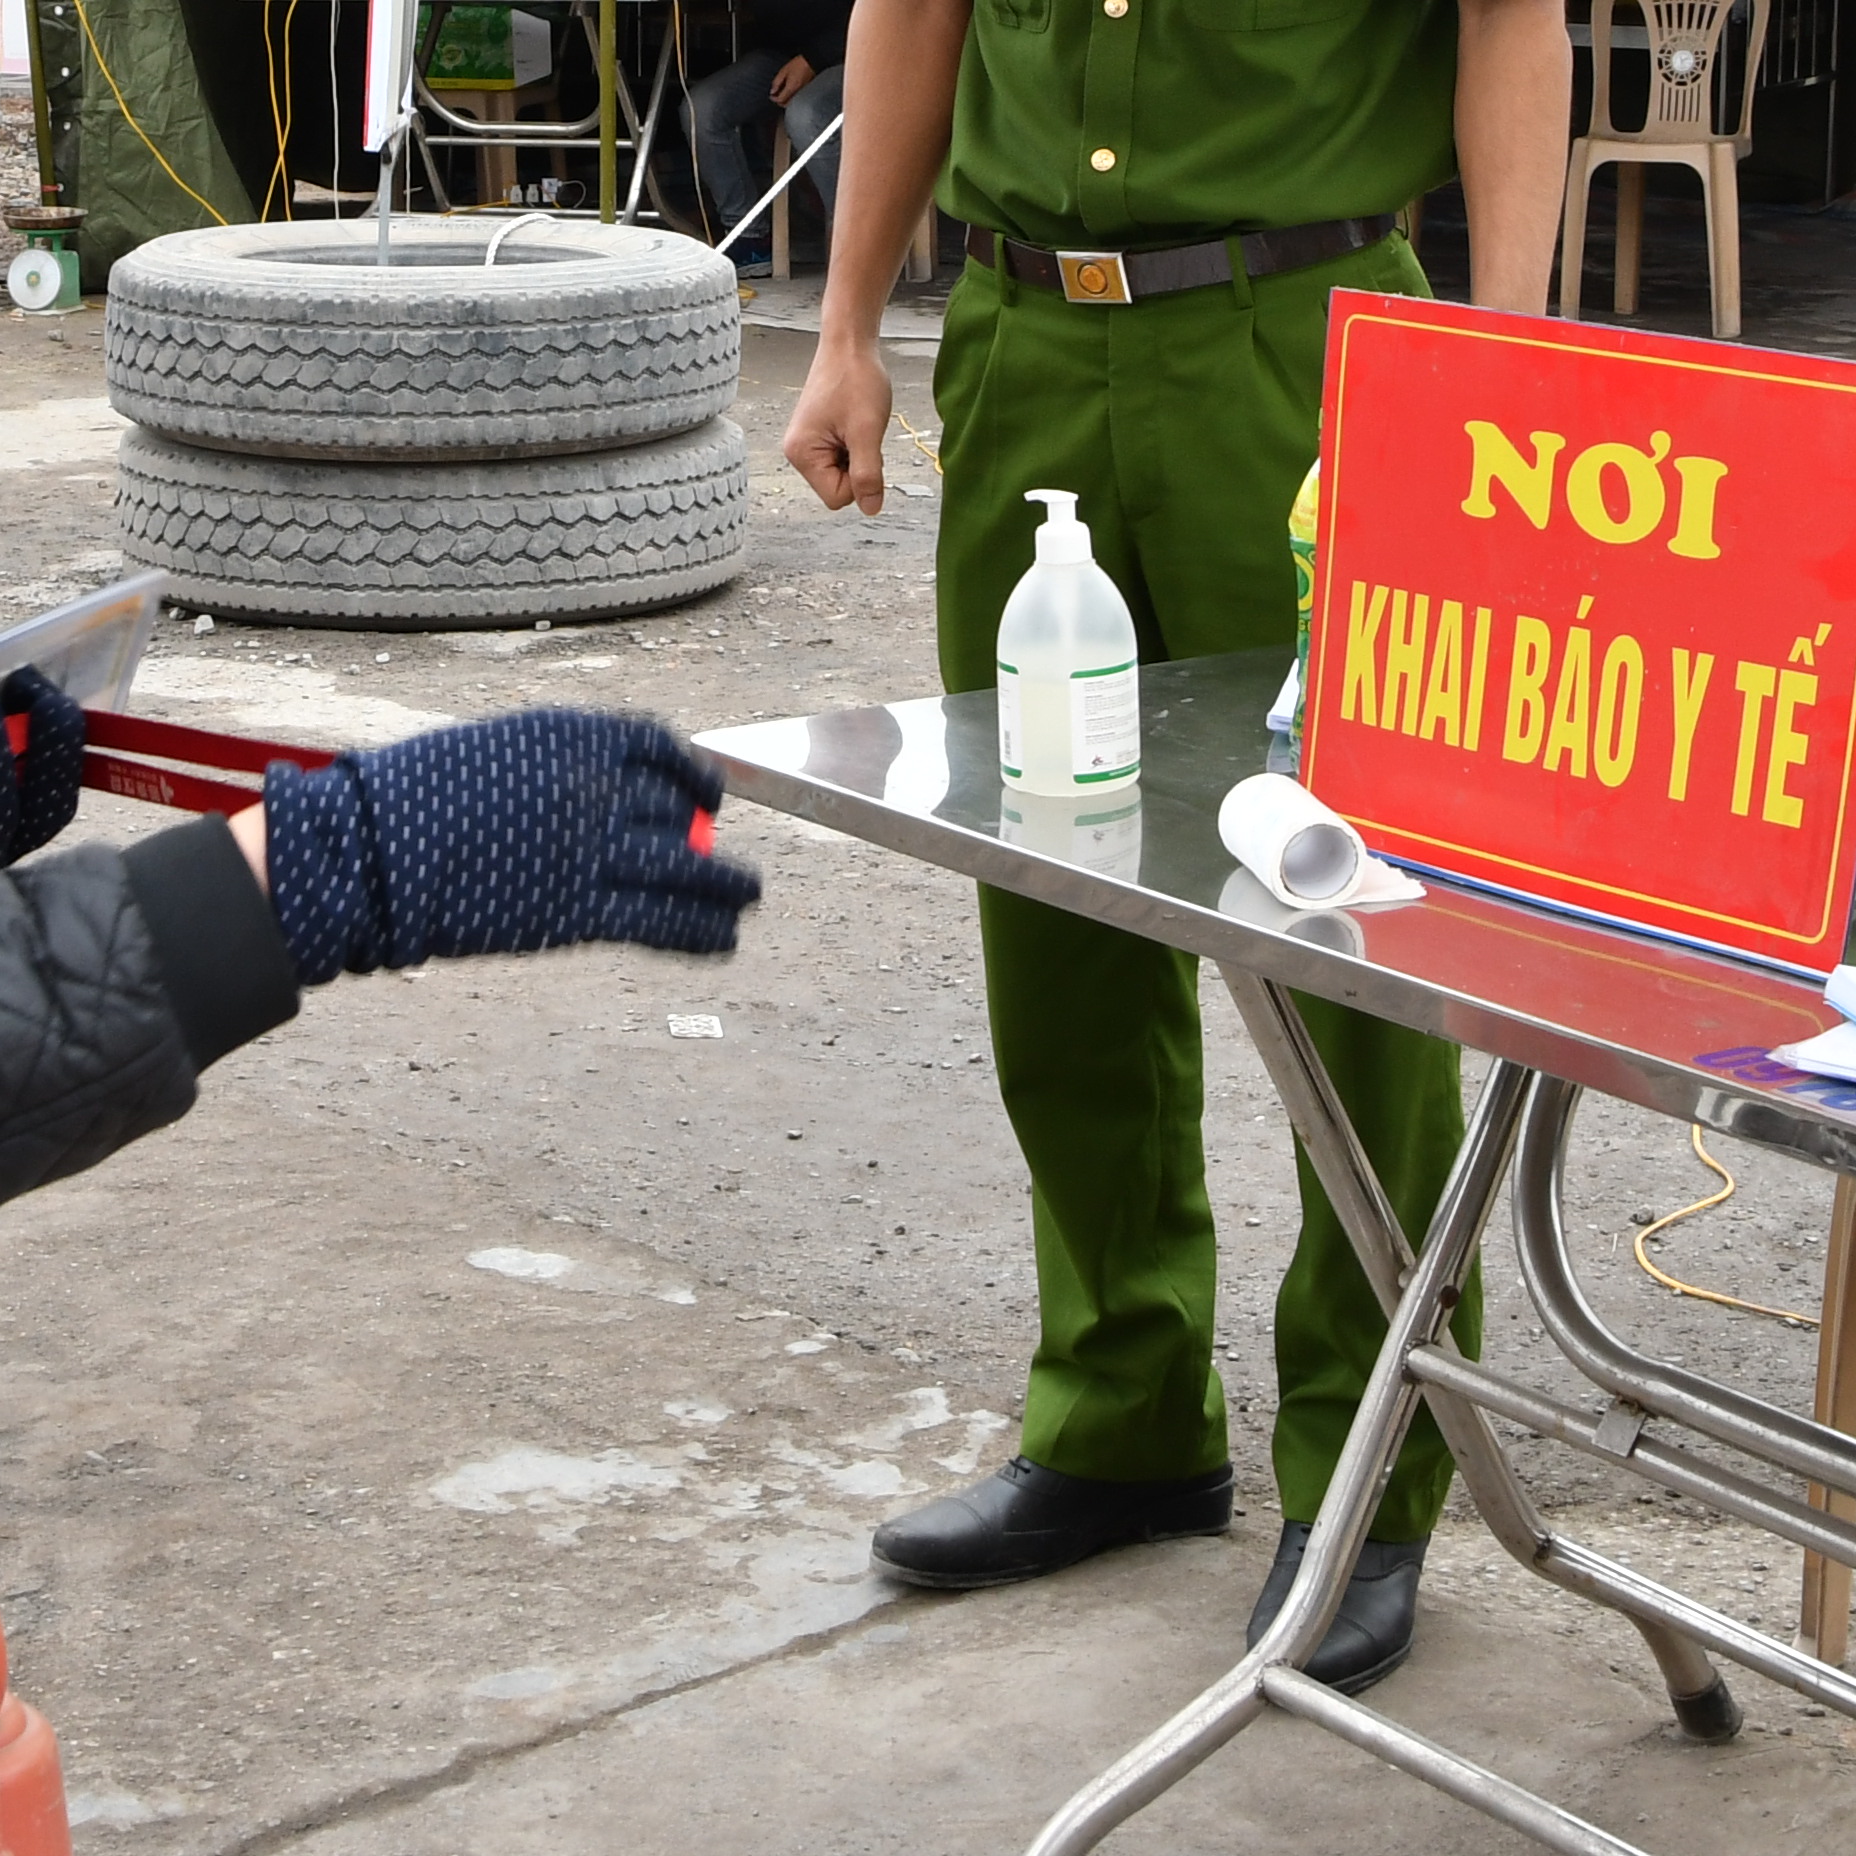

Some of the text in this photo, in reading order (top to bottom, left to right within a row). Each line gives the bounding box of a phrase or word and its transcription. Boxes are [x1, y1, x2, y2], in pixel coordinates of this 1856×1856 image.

[1460, 419, 1730, 560] NƠI
[1339, 580, 1832, 830] KHAI BÁO Y TẾ
